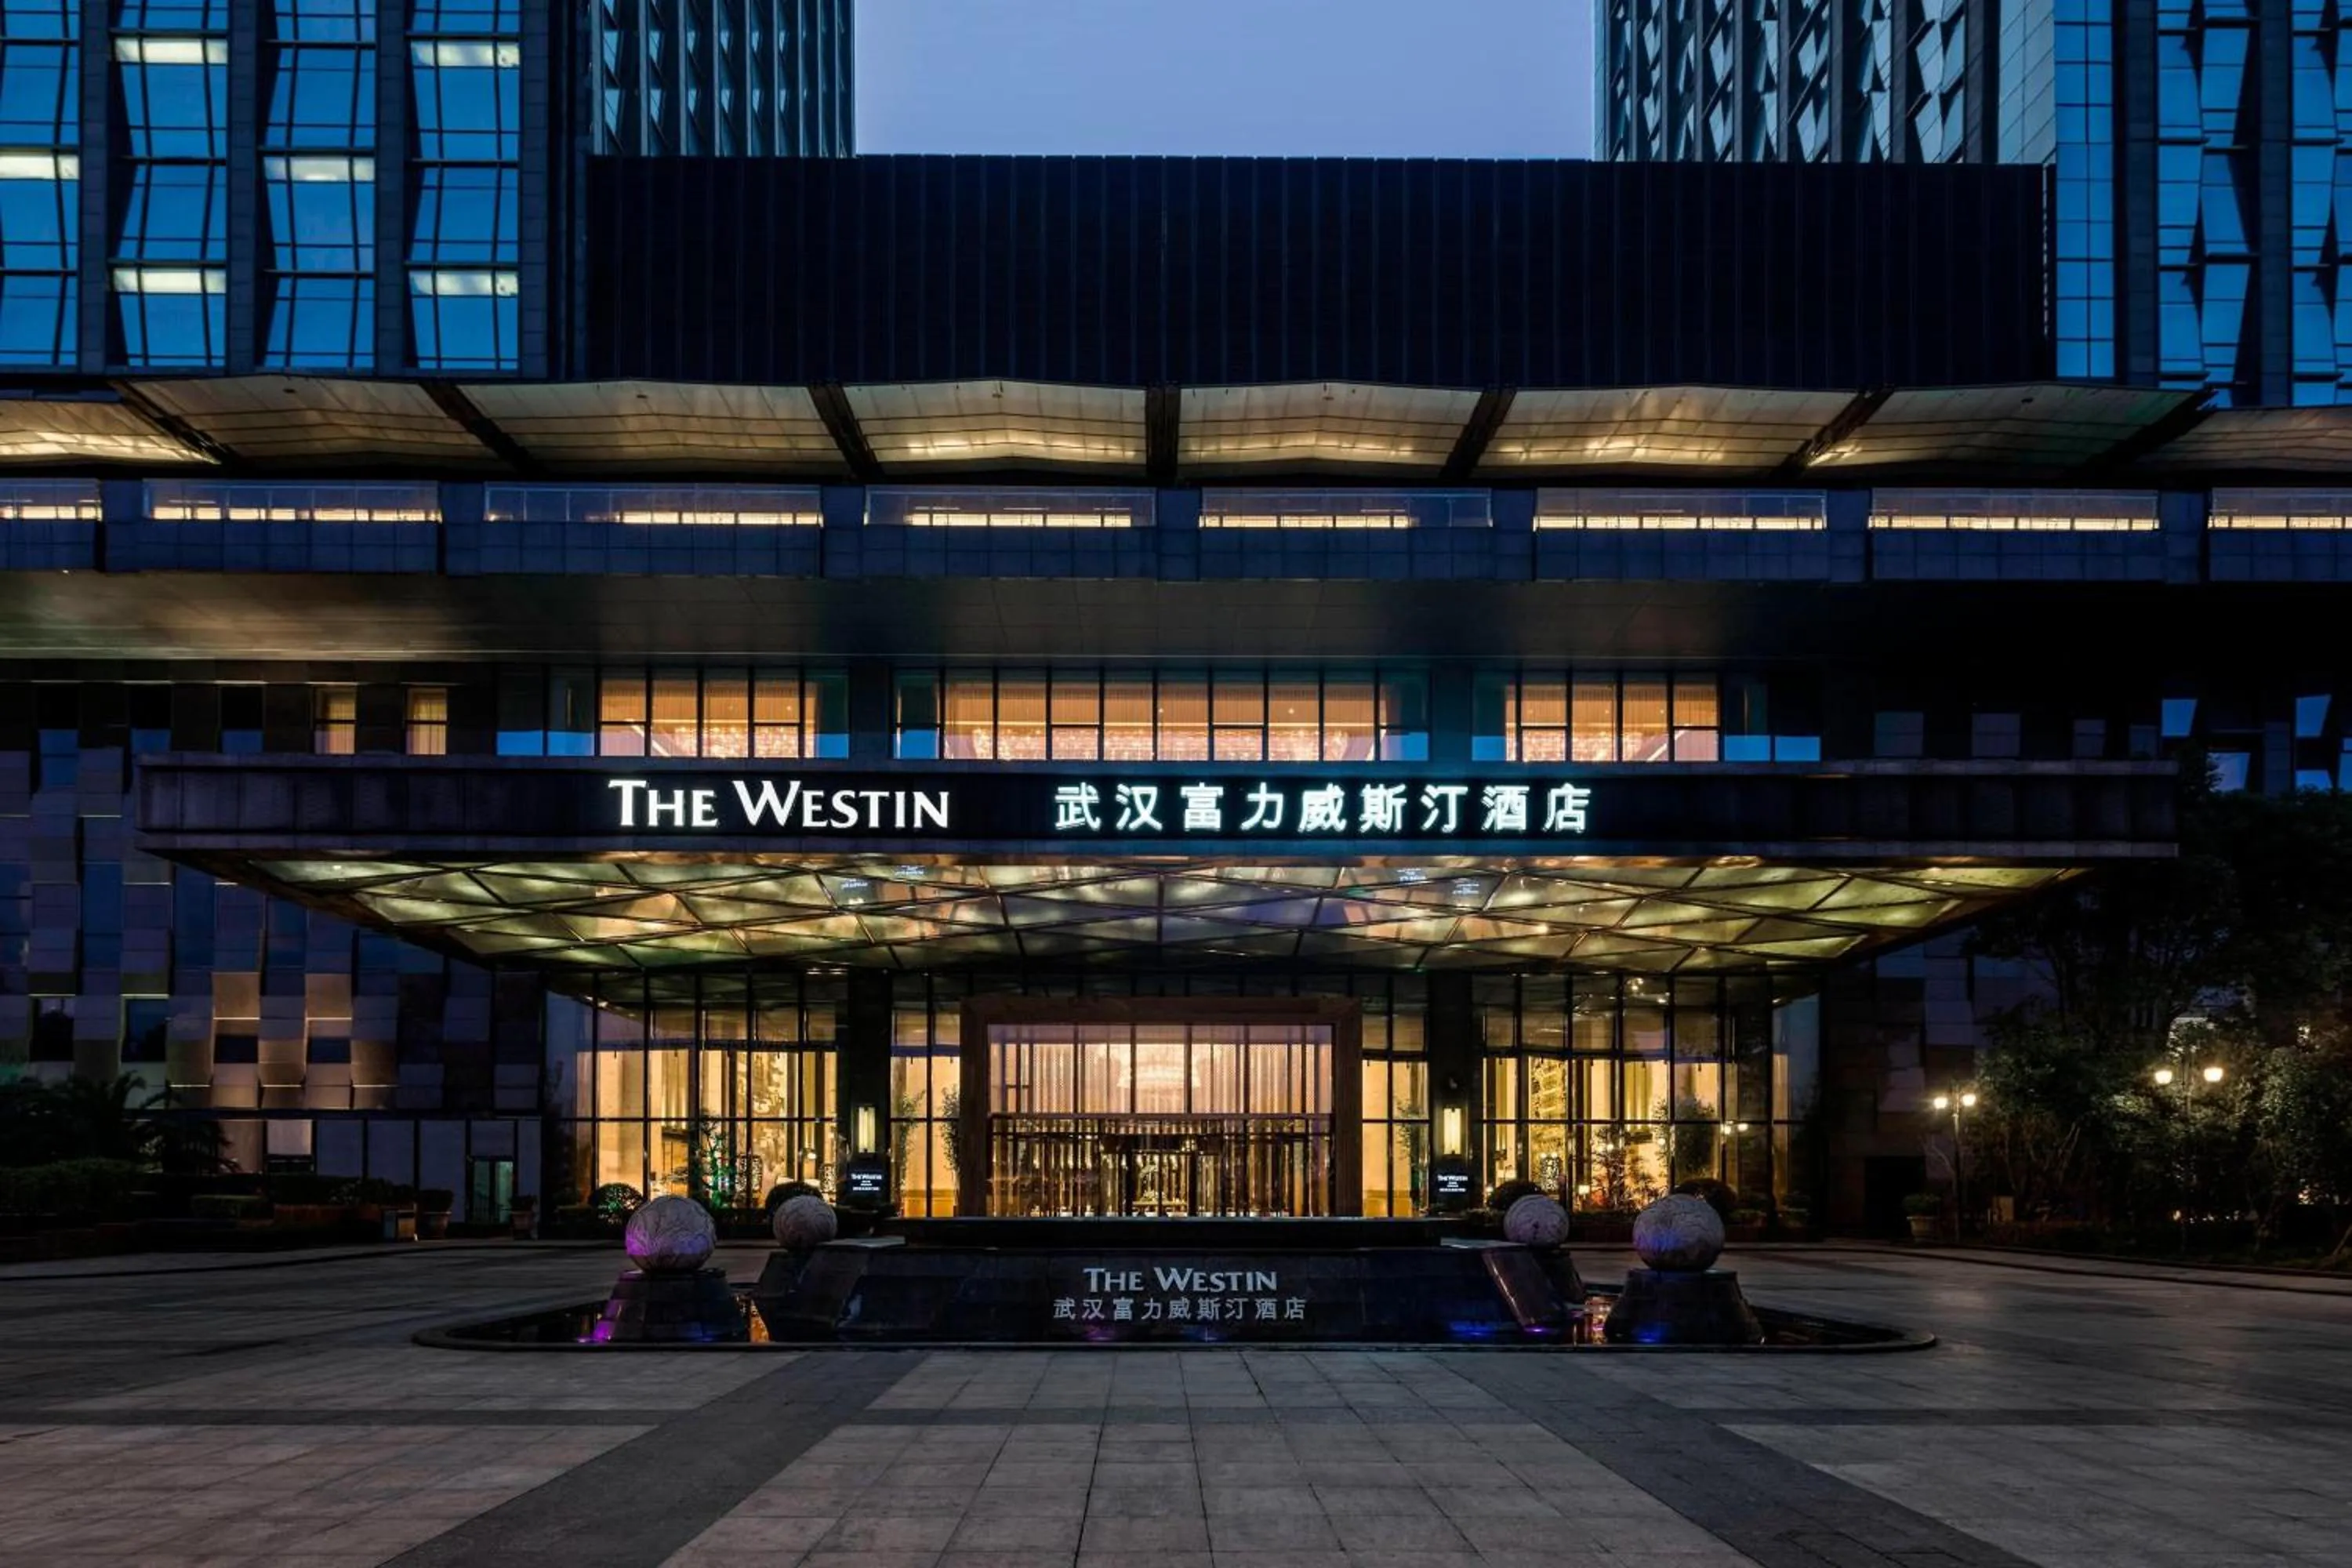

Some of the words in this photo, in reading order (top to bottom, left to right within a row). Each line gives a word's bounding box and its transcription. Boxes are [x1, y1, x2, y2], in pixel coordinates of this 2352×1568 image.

[608, 779, 718, 827] THE
[732, 781, 949, 828] WESTIN
[1054, 782, 1591, 833] 武汉富力威斯汀酒店
[1083, 1268, 1144, 1292] THE
[1154, 1267, 1276, 1292] WESTIN
[1053, 1297, 1306, 1320] 武汉富力威斯汀酒店
